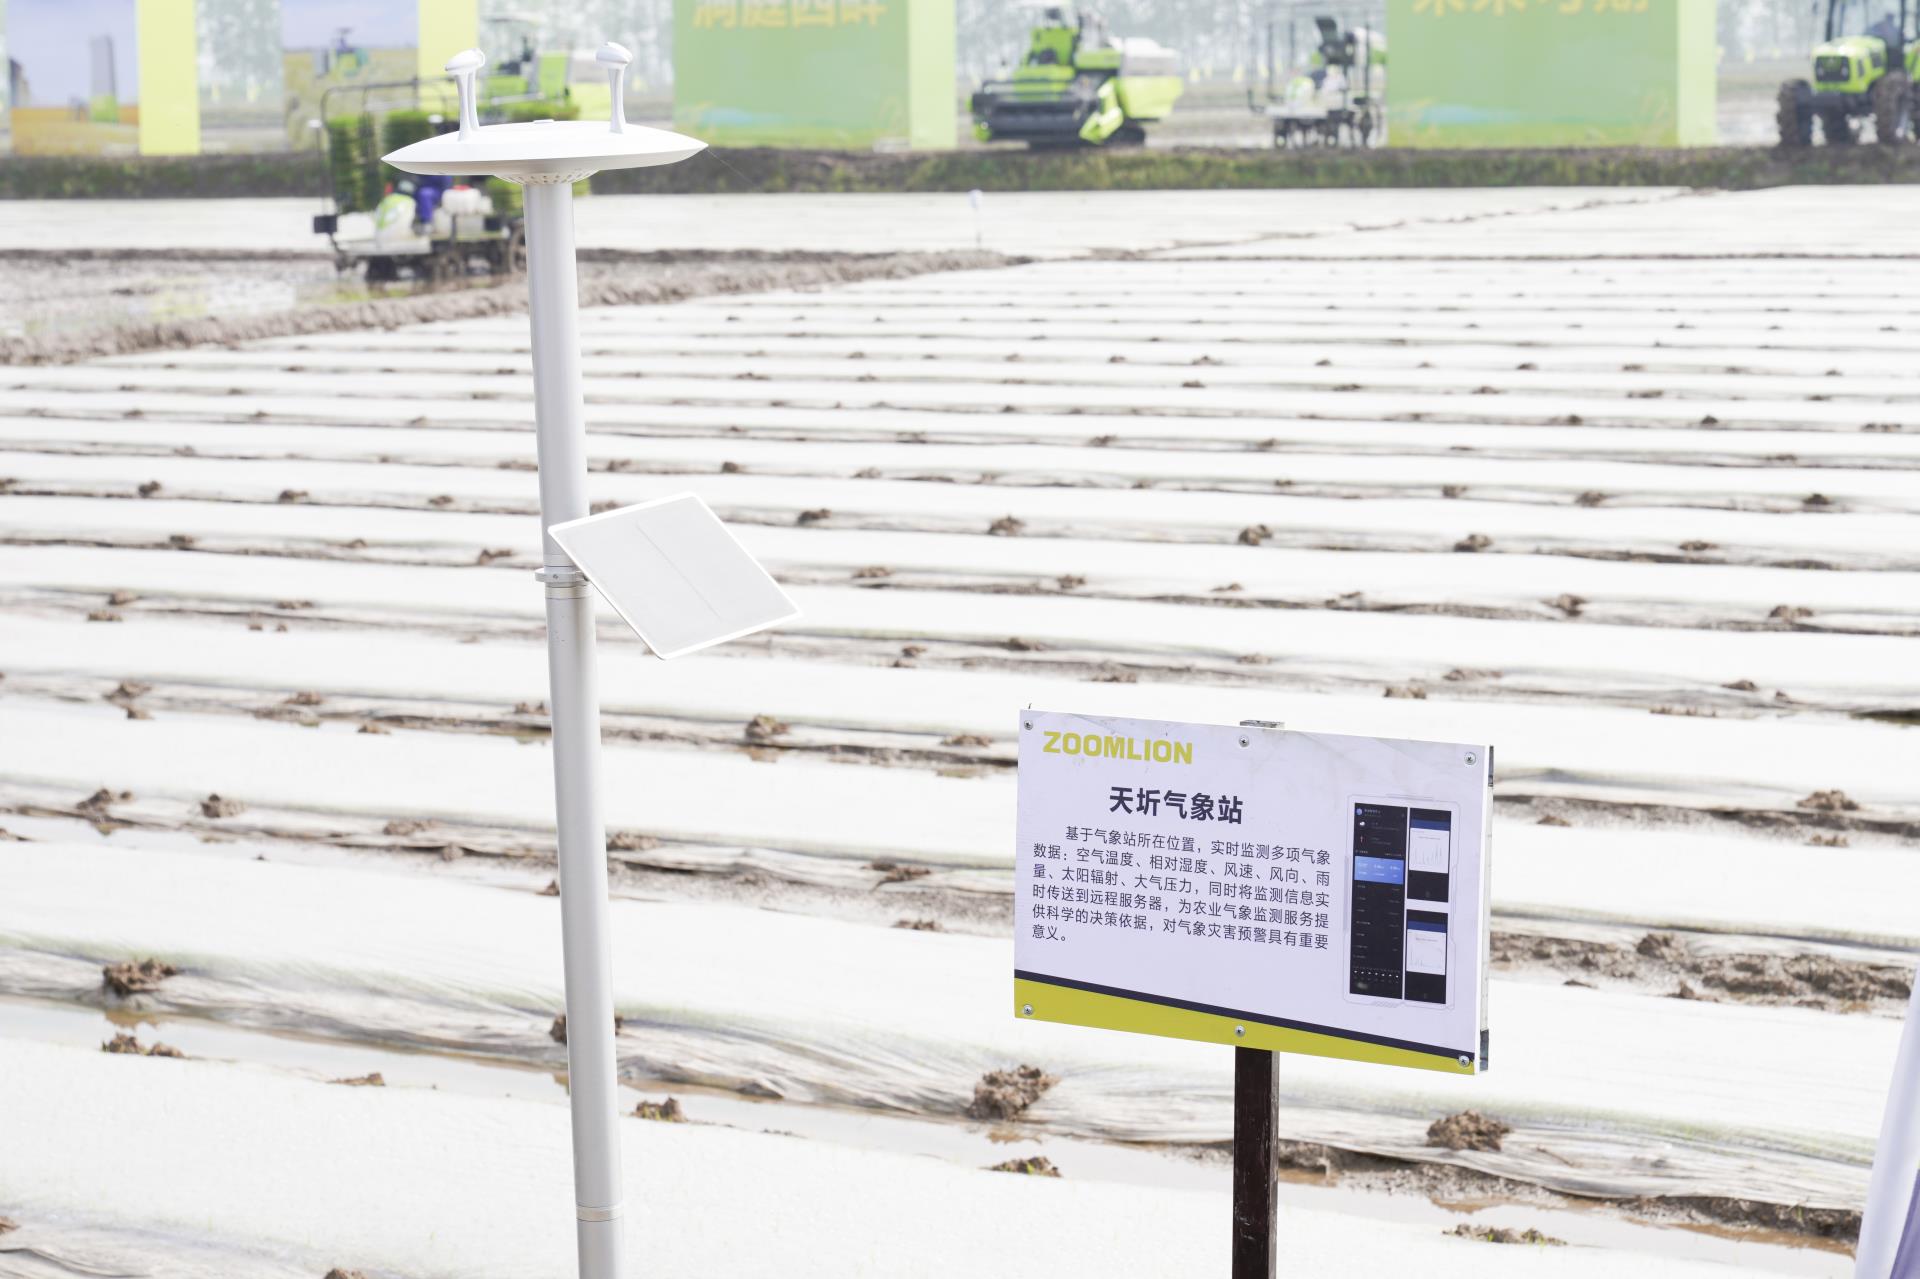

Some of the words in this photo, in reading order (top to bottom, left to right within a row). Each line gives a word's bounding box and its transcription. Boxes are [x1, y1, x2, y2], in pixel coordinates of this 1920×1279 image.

[1043, 731, 1193, 765] ZOOMLION
[1109, 786, 1243, 825] 天圻气象站
[1033, 843, 1330, 887] 数据：空气温度、相对湿度、风速、风向、雨
[1065, 826, 1331, 865] 基于气象站所在位置，实时监测多项气象
[1033, 863, 1330, 908] 量、太阳辐射、大气压力，同时将监测信息实
[1032, 884, 1329, 929] 时传送到远程服务器，为农业气象监测服务提
[1032, 904, 1328, 950] 供科学的决策依据，对气象灾害预警具有重要
[1032, 924, 1066, 942] 意义。
